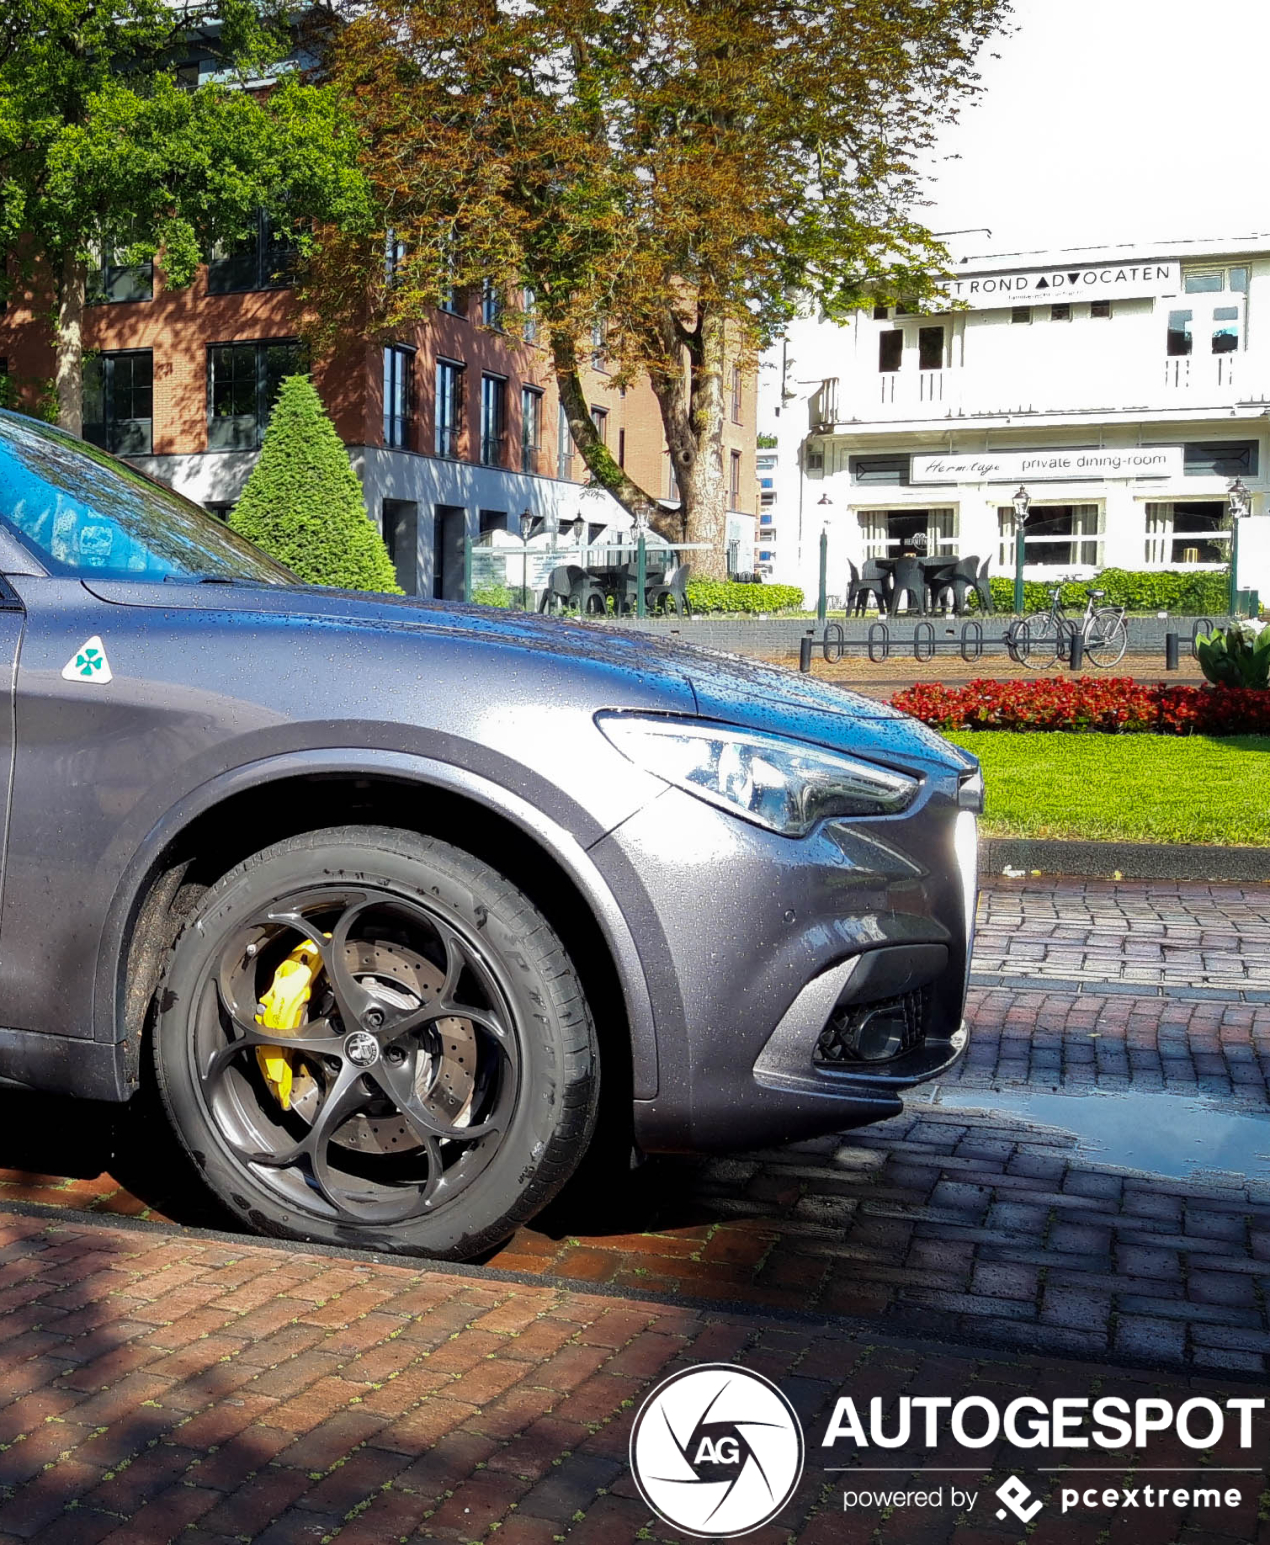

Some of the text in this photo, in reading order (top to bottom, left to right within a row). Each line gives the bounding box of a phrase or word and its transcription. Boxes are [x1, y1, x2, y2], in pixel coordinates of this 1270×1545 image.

[970, 277, 1028, 293] ROND
[1021, 457, 1071, 471] private
[1076, 455, 1167, 470] dining-room
